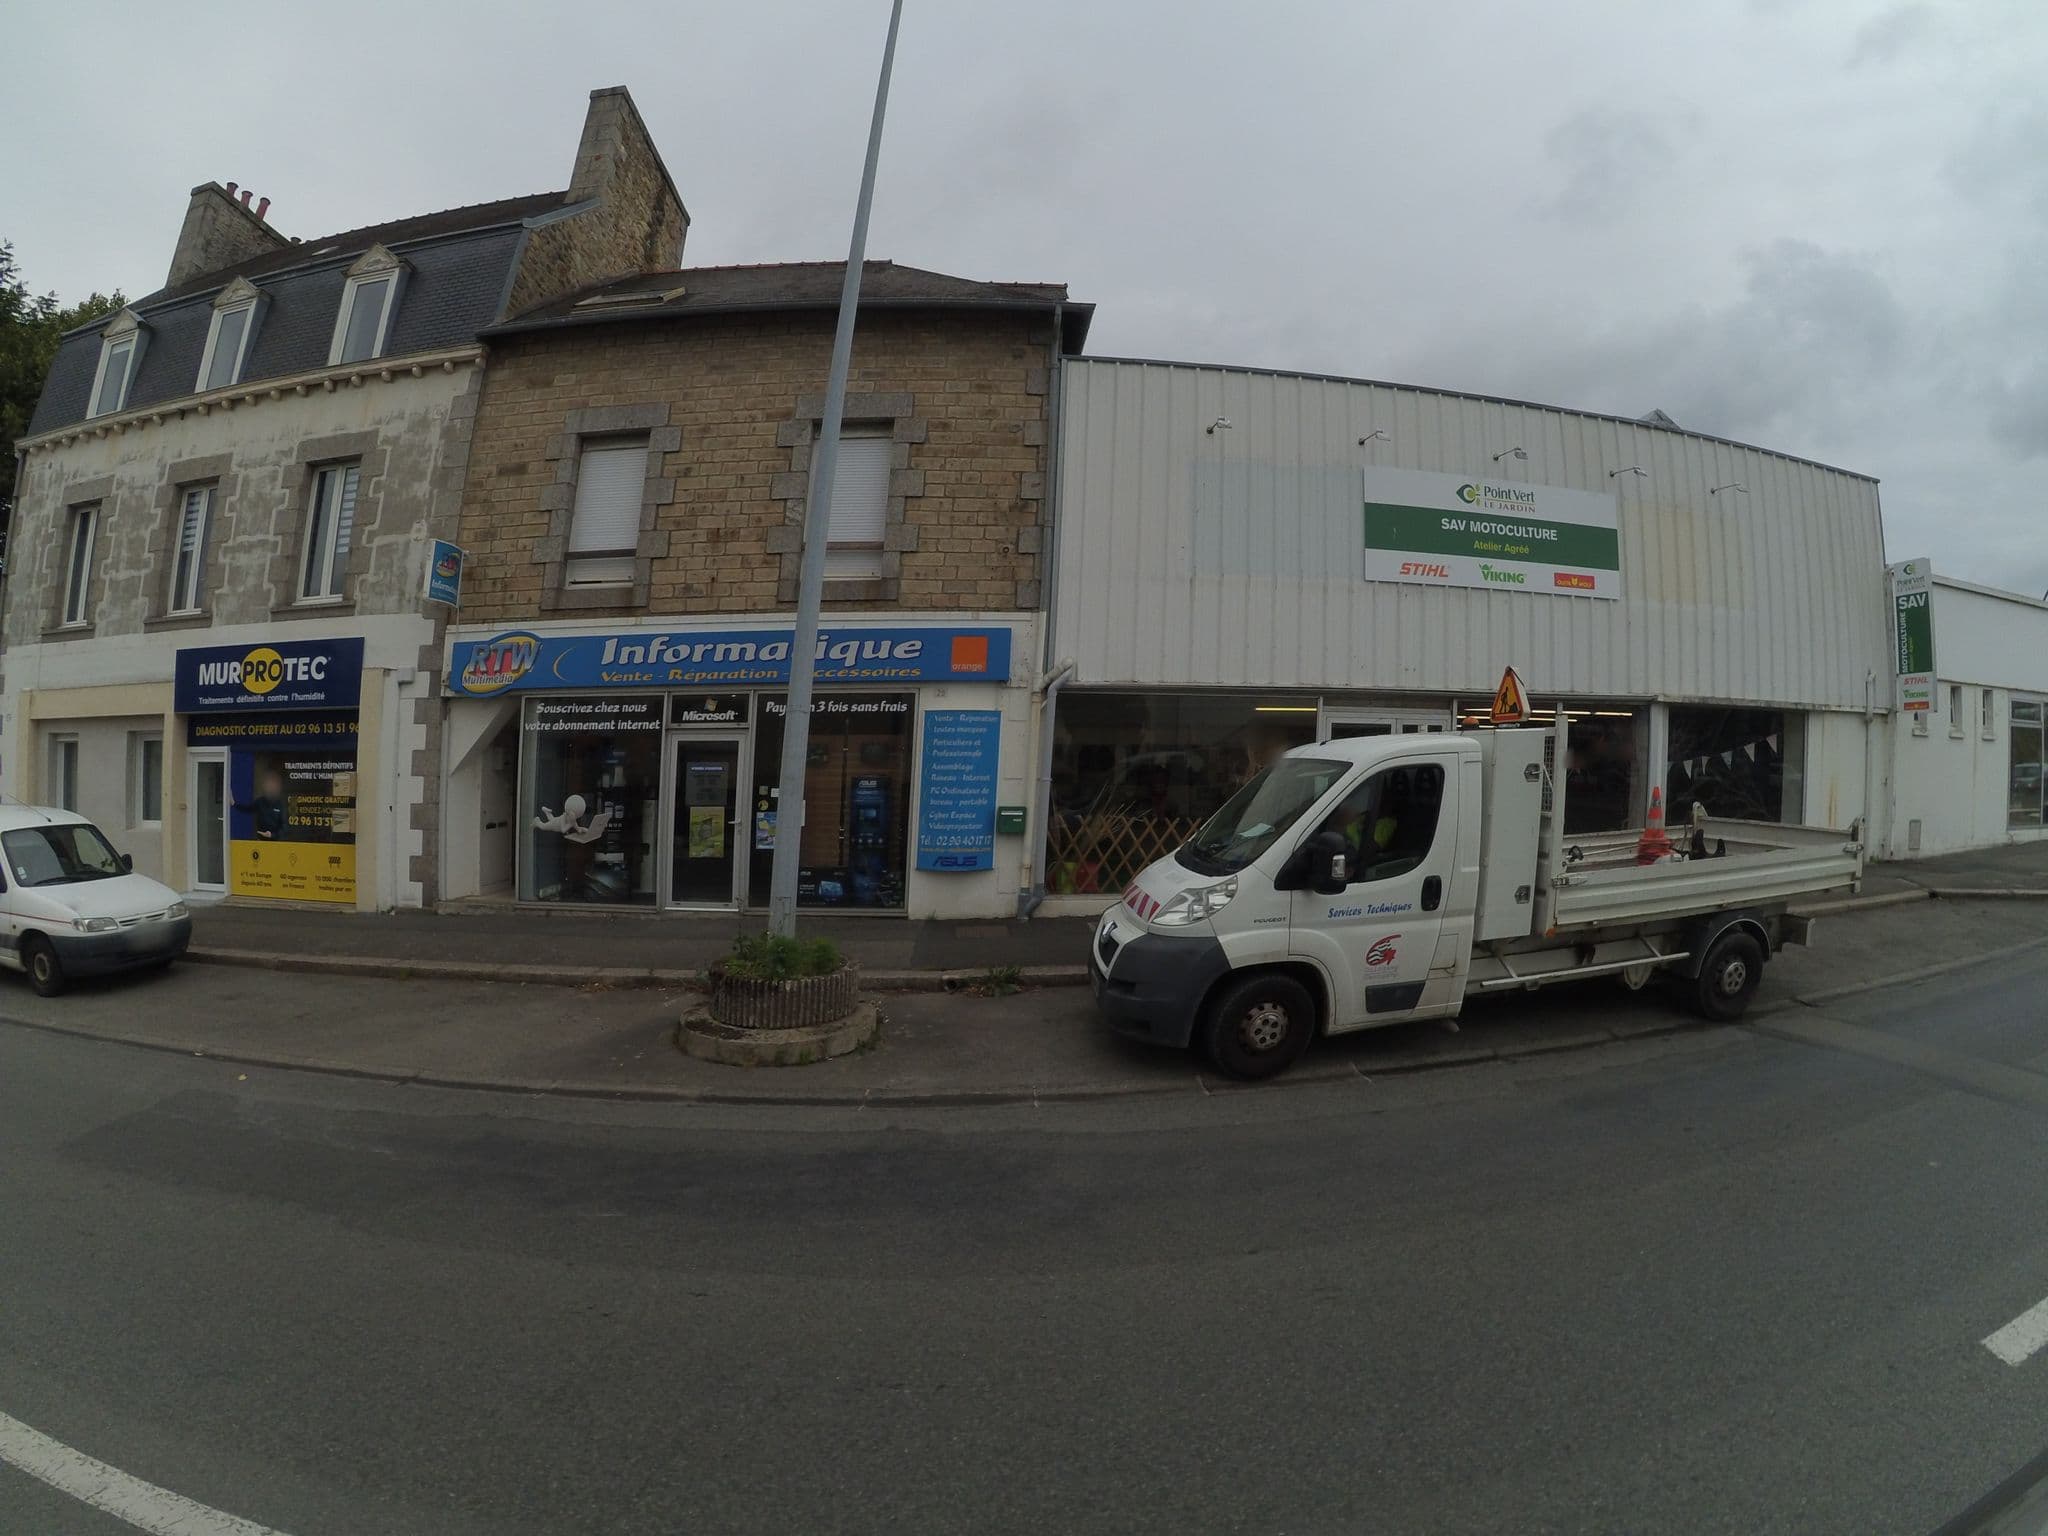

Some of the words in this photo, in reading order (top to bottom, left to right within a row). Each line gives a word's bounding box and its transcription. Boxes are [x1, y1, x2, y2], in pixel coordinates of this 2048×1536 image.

[1484, 486, 1511, 500] Point
[1513, 490, 1535, 503] Vert
[1498, 503, 1535, 512] JARDIN
[1441, 518, 1466, 531] SAV
[1470, 521, 1558, 540] MOTOCULTURE
[1473, 541, 1501, 551] Atelier
[1504, 544, 1529, 555] Agréé
[1400, 562, 1449, 578] STIHL
[1482, 570, 1525, 584] VIKING
[1899, 593, 1926, 609] SAV
[1900, 611, 1908, 673] MOTOCULTURE
[469, 641, 542, 672] RTW
[601, 636, 923, 667] Informaique
[199, 656, 328, 686] MURPROTEC
[601, 671, 653, 682] Vente
[668, 668, 778, 682] Réparation
[813, 667, 921, 678] ccessoires
[952, 664, 983, 672] orange
[1904, 676, 1928, 685] STIHL
[199, 696, 234, 704] Traitements
[236, 695, 264, 703] définitifs
[267, 694, 288, 702] contre
[536, 702, 592, 713] Souscrivez
[594, 701, 620, 713] chez
[622, 703, 648, 713] nous
[765, 701, 787, 716] Pay
[816, 701, 826, 712] 3
[827, 700, 849, 712] fois
[850, 702, 878, 712] sans
[879, 700, 908, 712] frais
[682, 710, 736, 721] Microsoft
[196, 725, 246, 736] DIAGNOSTIC
[248, 724, 279, 736] OFFERT
[280, 724, 293, 735] AU
[295, 723, 306, 734] 02
[308, 723, 321, 734] 96
[323, 723, 333, 734] 13
[335, 723, 346, 733] 51
[349, 722, 359, 734] 96
[525, 720, 551, 731] votre
[552, 719, 615, 730] abonnement
[285, 762, 321, 770] TRAITEMENTS
[289, 772, 312, 780] CONTRE
[930, 786, 940, 794] PC
[289, 816, 299, 825] 02
[300, 816, 311, 826] 96
[314, 816, 323, 826] 13
[324, 817, 333, 826] 51
[936, 835, 948, 846] 02
[962, 835, 975, 846] 40
[1327, 906, 1362, 919] Services
[1367, 902, 1413, 914] Techniques
